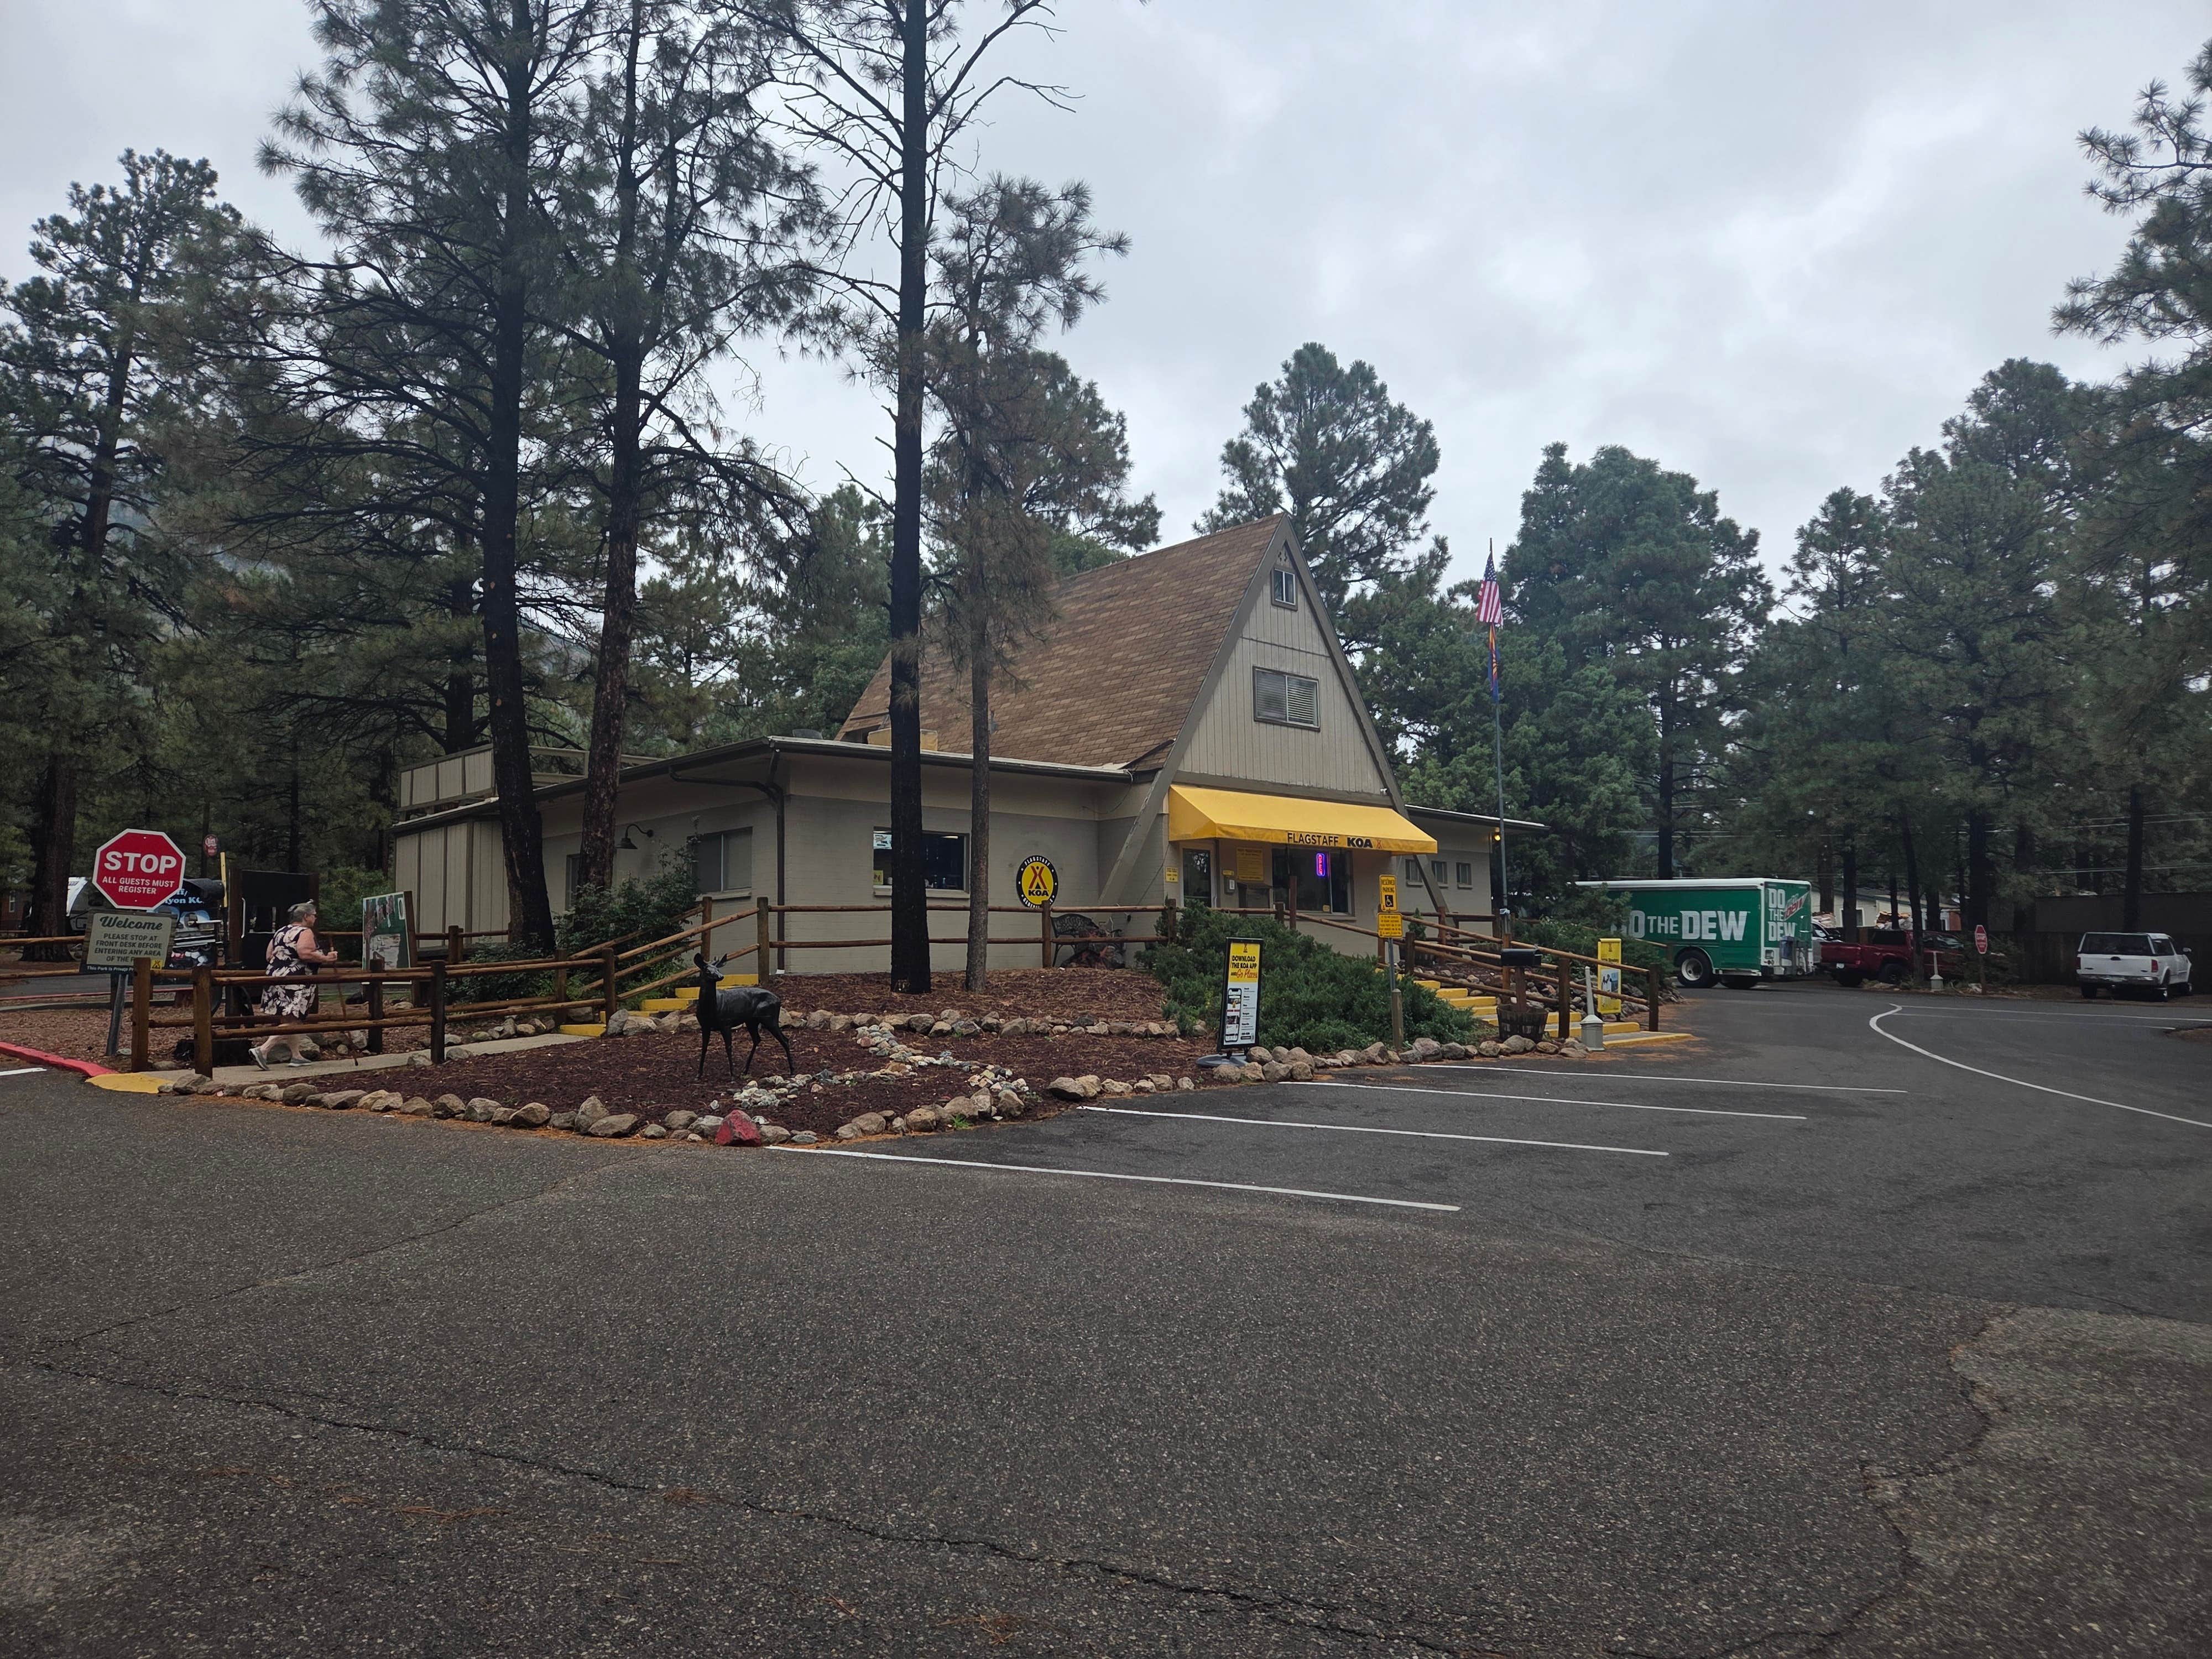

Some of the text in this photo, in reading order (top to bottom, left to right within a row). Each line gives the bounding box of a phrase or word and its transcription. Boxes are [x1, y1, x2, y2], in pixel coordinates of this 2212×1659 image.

[1287, 832, 1373, 849] FLAGSTAFF KOA
[104, 851, 177, 874] STOP
[118, 886, 157, 894] REGISTER
[1768, 888, 1785, 909] DO
[100, 916, 163, 930] Welcome
[1768, 909, 1785, 921] THE
[1647, 916, 1678, 934] THE
[1679, 910, 1747, 941] DEW
[1767, 922, 1796, 941] DEW
